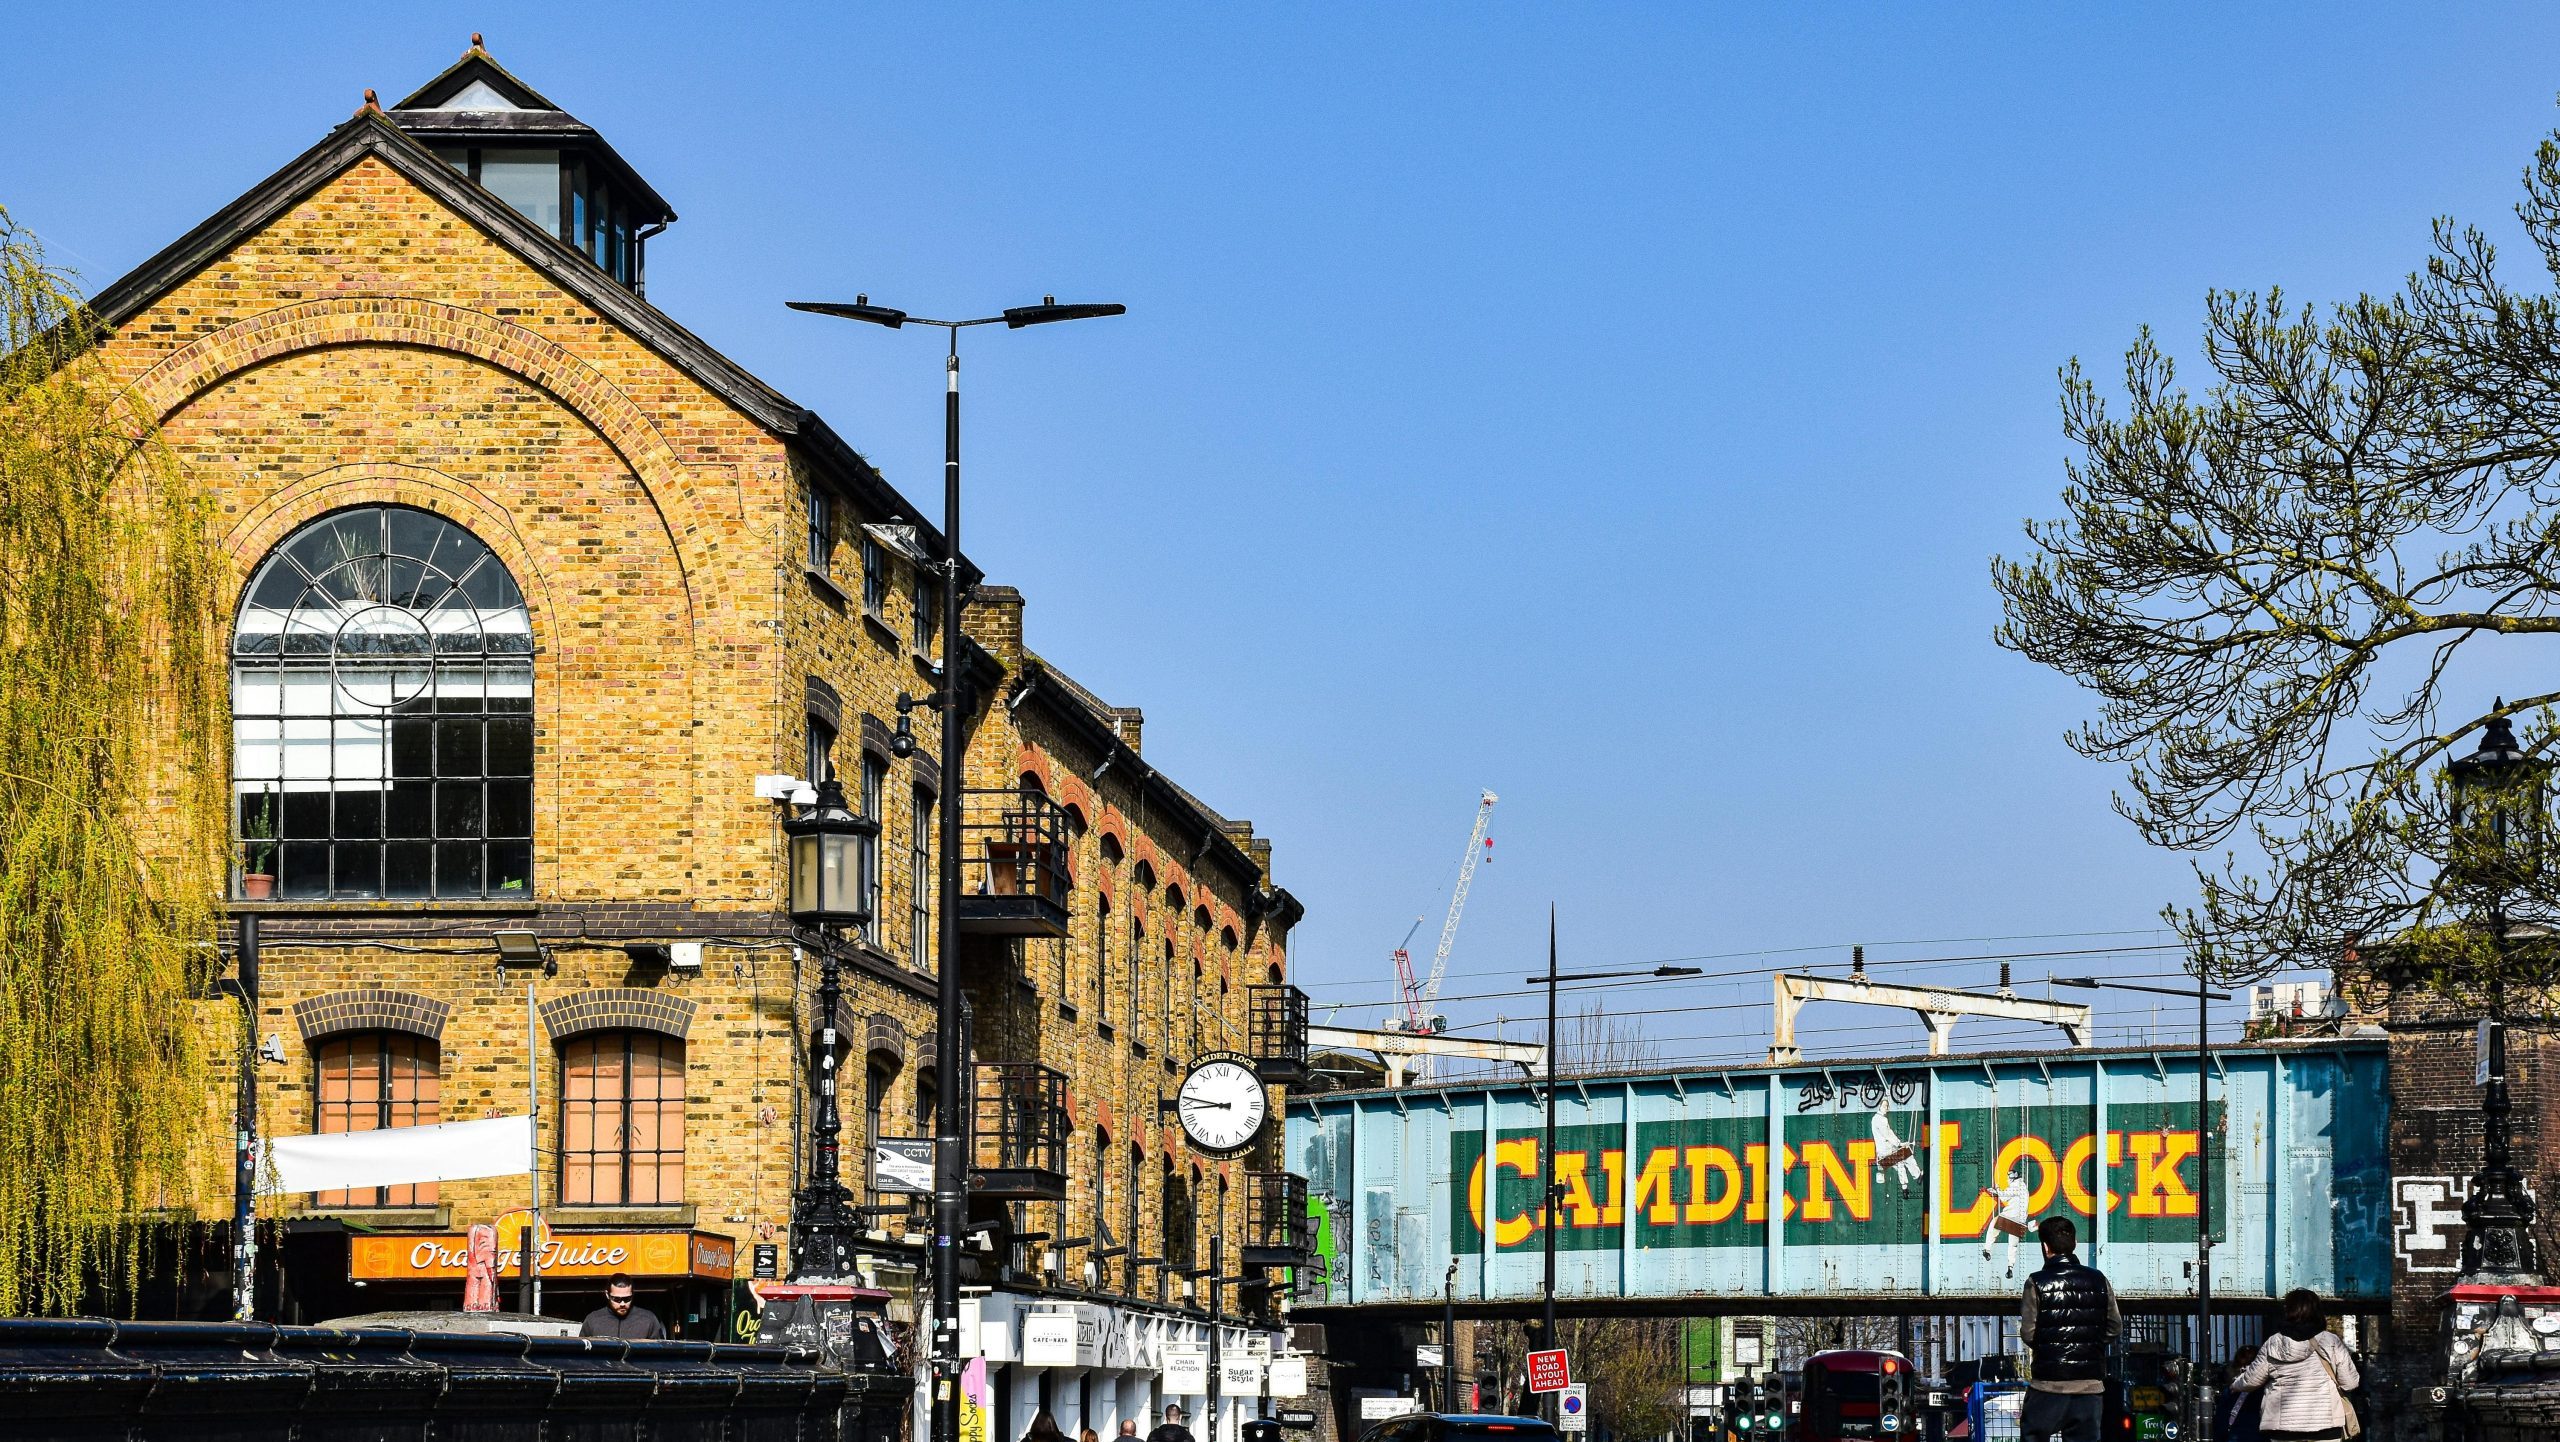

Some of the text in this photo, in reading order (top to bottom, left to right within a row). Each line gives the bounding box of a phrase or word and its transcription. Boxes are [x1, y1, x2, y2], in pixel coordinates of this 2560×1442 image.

[1190, 1052, 1258, 1070] CAMDEN LOCK
[1199, 1069, 1212, 1082] XI
[1215, 1066, 1230, 1077] XII
[1186, 1083, 1199, 1094] X
[903, 1148, 931, 1158] CCTV
[1231, 1144, 1256, 1160] HALL
[1468, 1137, 1876, 1247] CAMDEN
[1922, 1120, 2200, 1239] LOCK
[410, 1241, 523, 1274] Orage
[537, 1240, 629, 1270] Juice
[1537, 1354, 1557, 1363] NEW
[1536, 1362, 1560, 1371] ROAD
[1228, 1368, 1254, 1378] Sugar
[1533, 1370, 1565, 1380] LAYOUT
[1535, 1378, 1564, 1388] AHEAD
[960, 1392, 979, 1426] Socks
